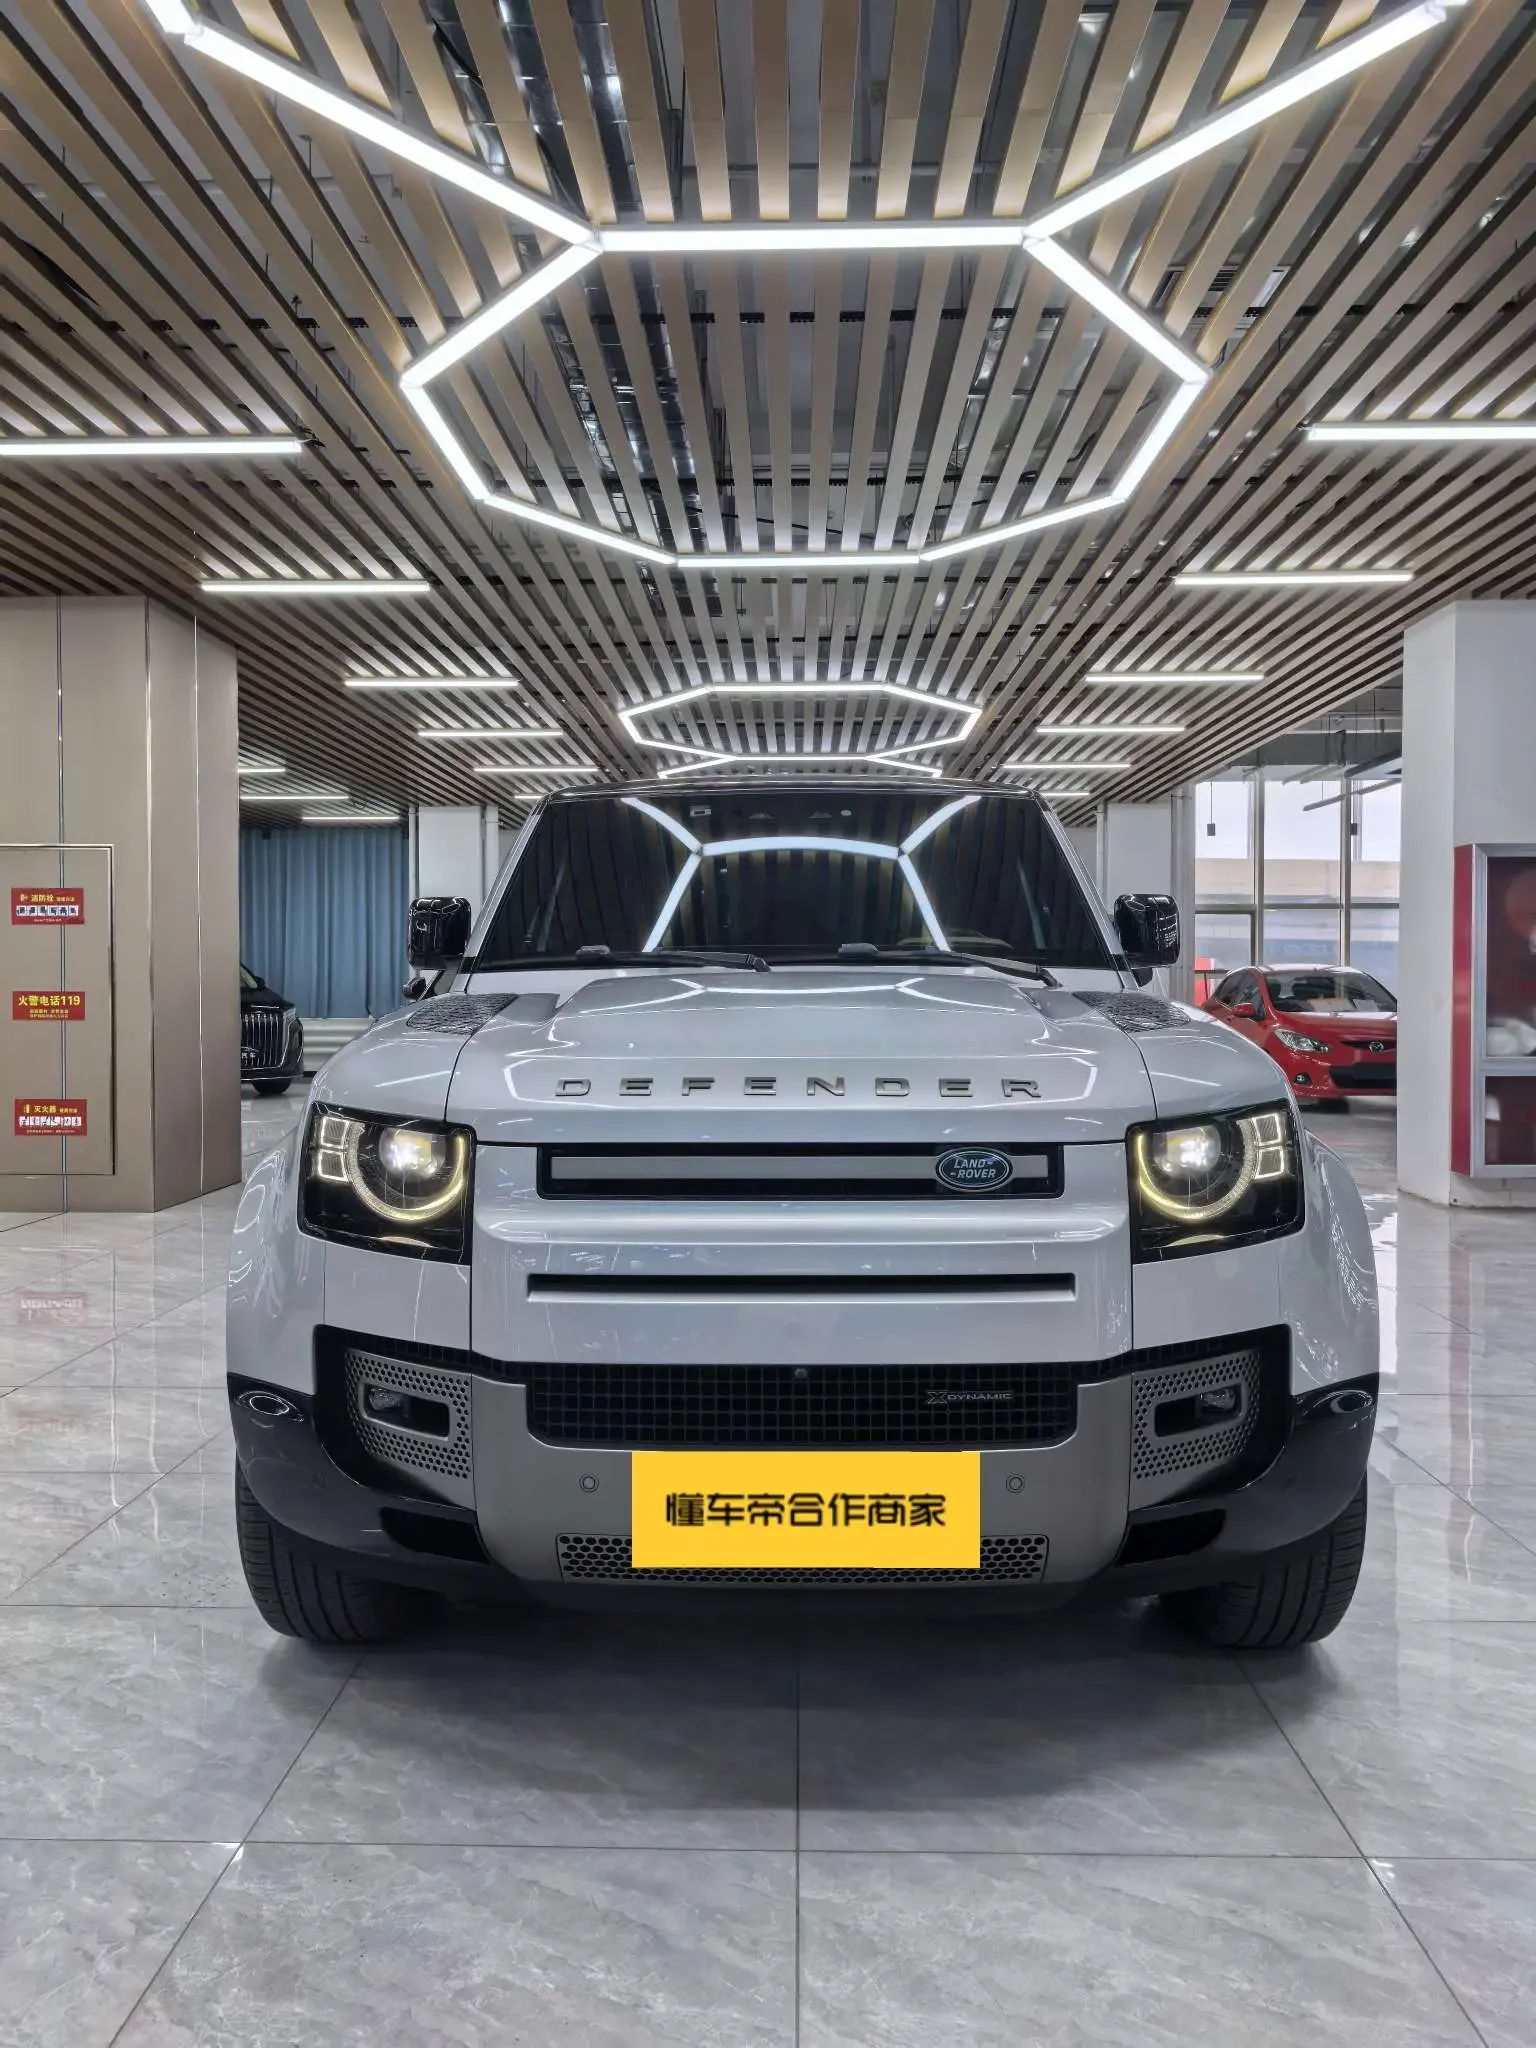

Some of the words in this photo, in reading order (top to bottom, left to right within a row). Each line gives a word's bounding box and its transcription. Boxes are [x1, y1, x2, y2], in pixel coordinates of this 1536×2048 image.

[18, 995, 81, 1006] 火警电话119
[555, 1076, 1042, 1098] DEFENDER
